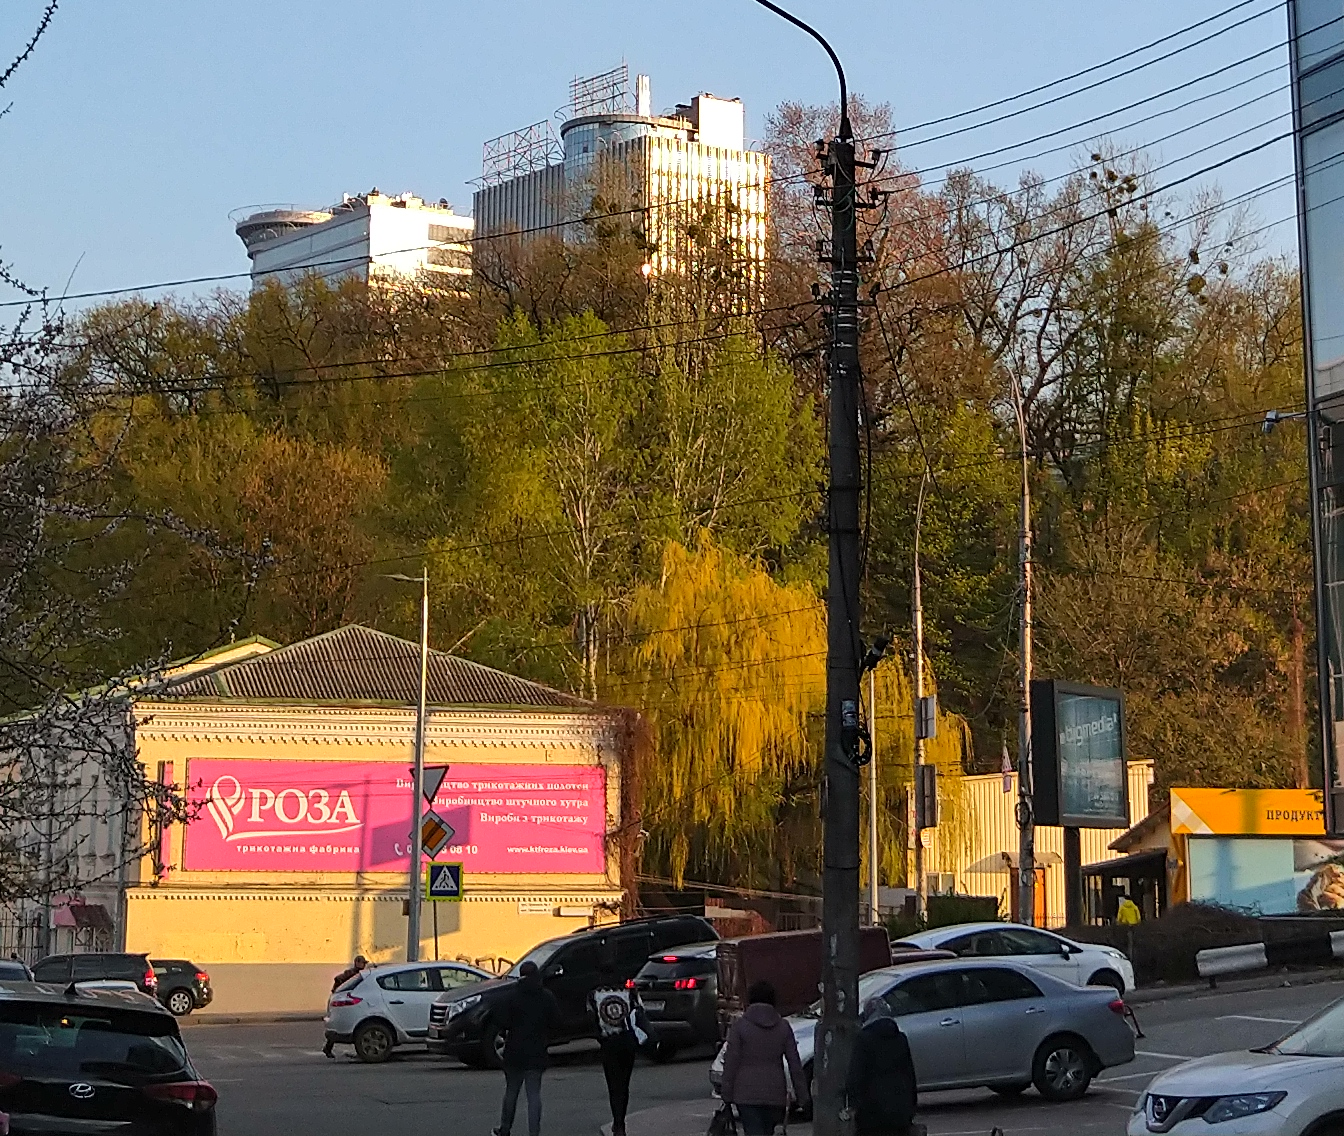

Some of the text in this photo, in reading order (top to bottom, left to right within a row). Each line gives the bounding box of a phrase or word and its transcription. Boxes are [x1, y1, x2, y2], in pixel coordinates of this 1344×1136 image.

[472, 781, 544, 791] трикотажних
[247, 788, 361, 824] РОЗА
[506, 798, 557, 807] штучного
[560, 799, 589, 808] хутра
[480, 813, 520, 824] Вироби
[531, 816, 588, 825] трикотажу
[1266, 809, 1324, 823] ПРОДУКТ
[236, 844, 361, 854] трикотажна фабрика
[466, 845, 478, 855] 10
